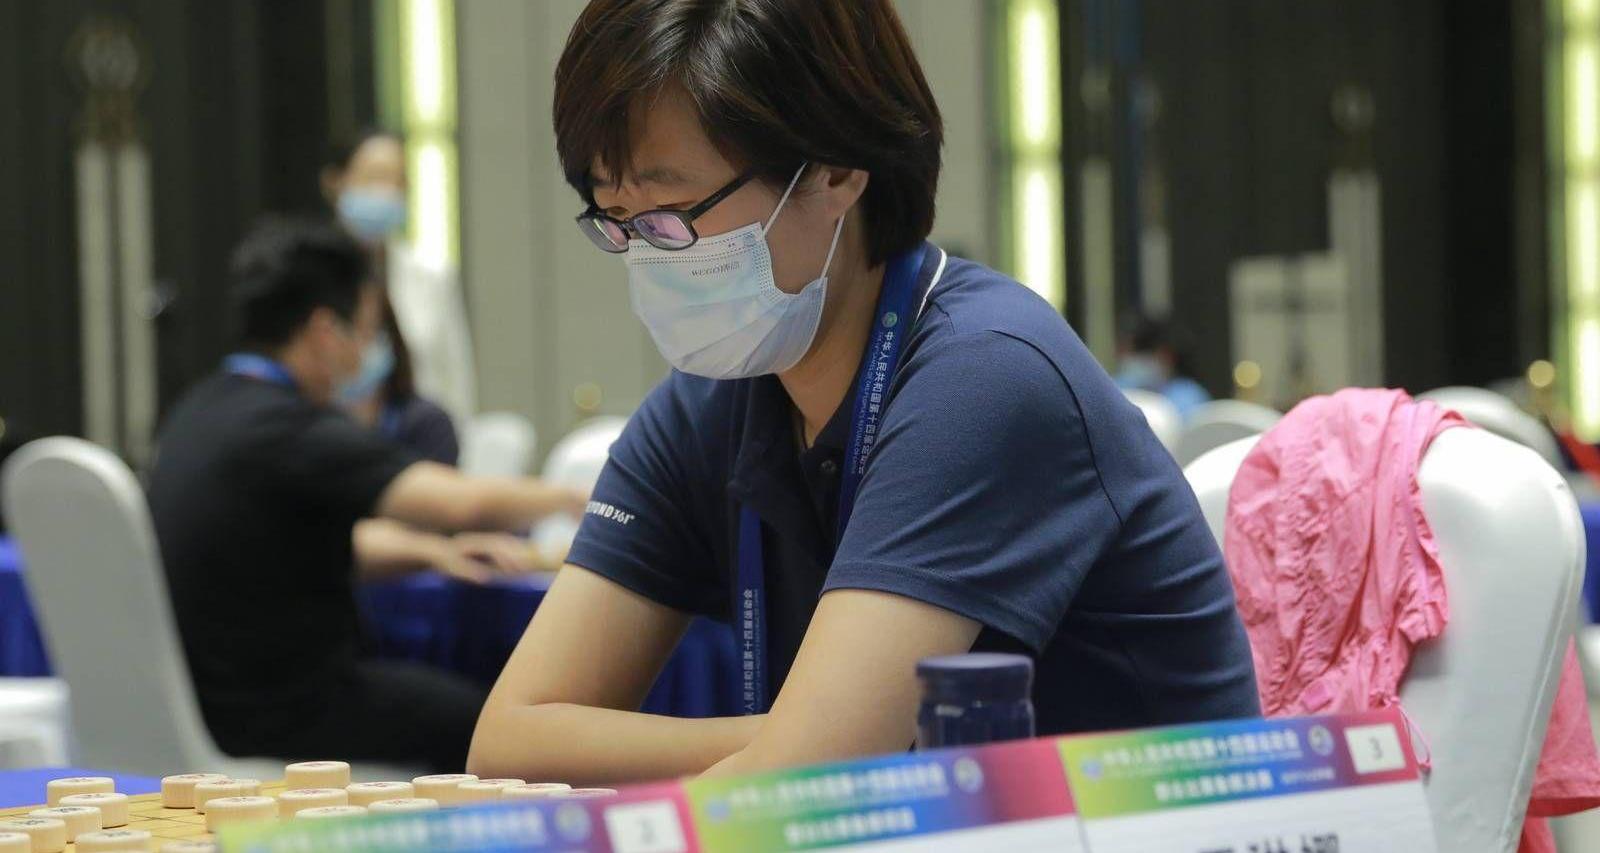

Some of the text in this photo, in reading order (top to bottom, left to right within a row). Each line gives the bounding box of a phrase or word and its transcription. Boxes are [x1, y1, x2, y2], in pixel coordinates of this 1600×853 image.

[743, 589, 754, 715] 人民共和国第十四届运动会
